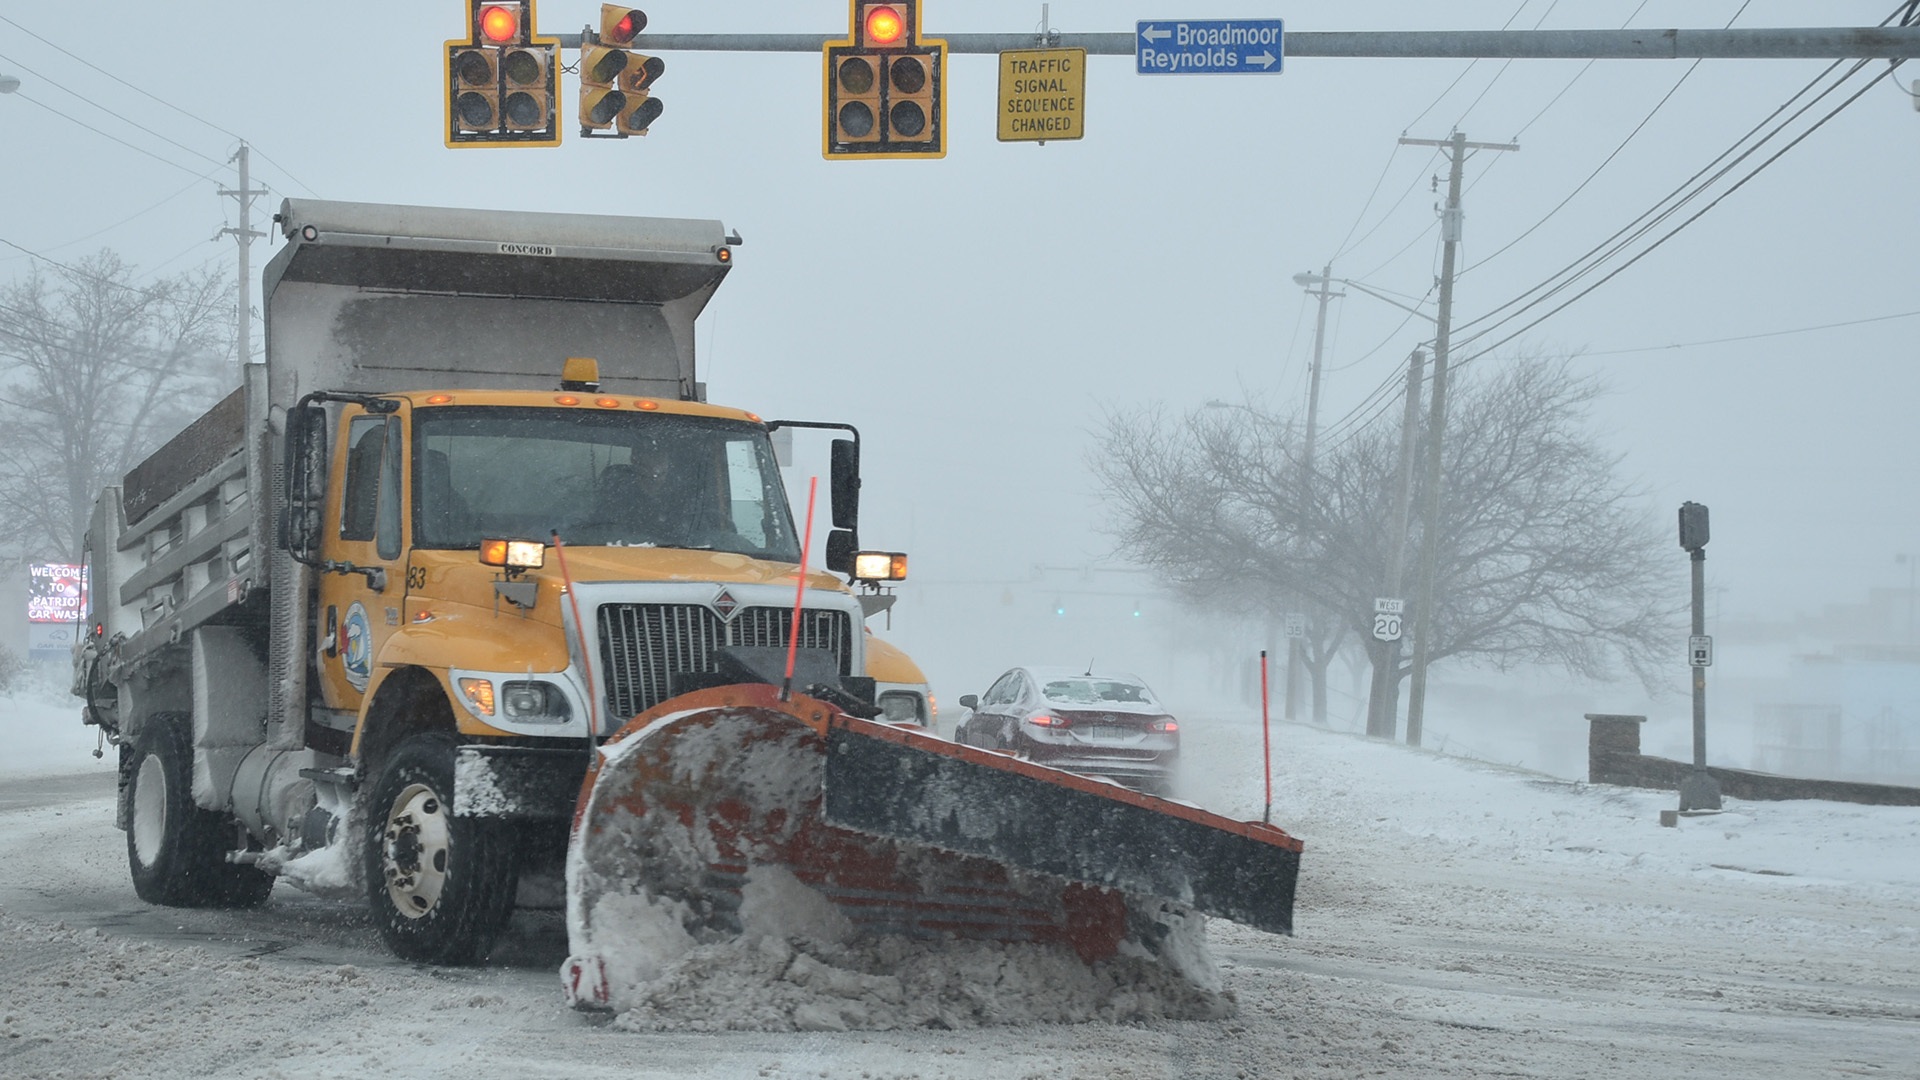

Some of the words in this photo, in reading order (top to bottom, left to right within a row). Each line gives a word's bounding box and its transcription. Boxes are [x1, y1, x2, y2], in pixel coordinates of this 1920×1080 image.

[1177, 23, 1279, 46] Broadmoor
[1010, 58, 1071, 74] TRAFFIC
[1142, 48, 1238, 71] Reynolds
[1014, 78, 1068, 94] SIGNAL
[1007, 97, 1075, 114] SEQUENCE
[1011, 116, 1071, 133] CHANGED
[501, 243, 553, 256] CONCORD
[31, 567, 87, 577] WELCOME
[408, 566, 426, 589] 83
[49, 583, 65, 592] TO
[33, 597, 83, 606] PATRIOT
[1379, 600, 1400, 610] WEST
[28, 610, 50, 618] CAR
[53, 610, 86, 619] WASH
[1287, 626, 1302, 636] 35
[1375, 619, 1399, 636] 20
